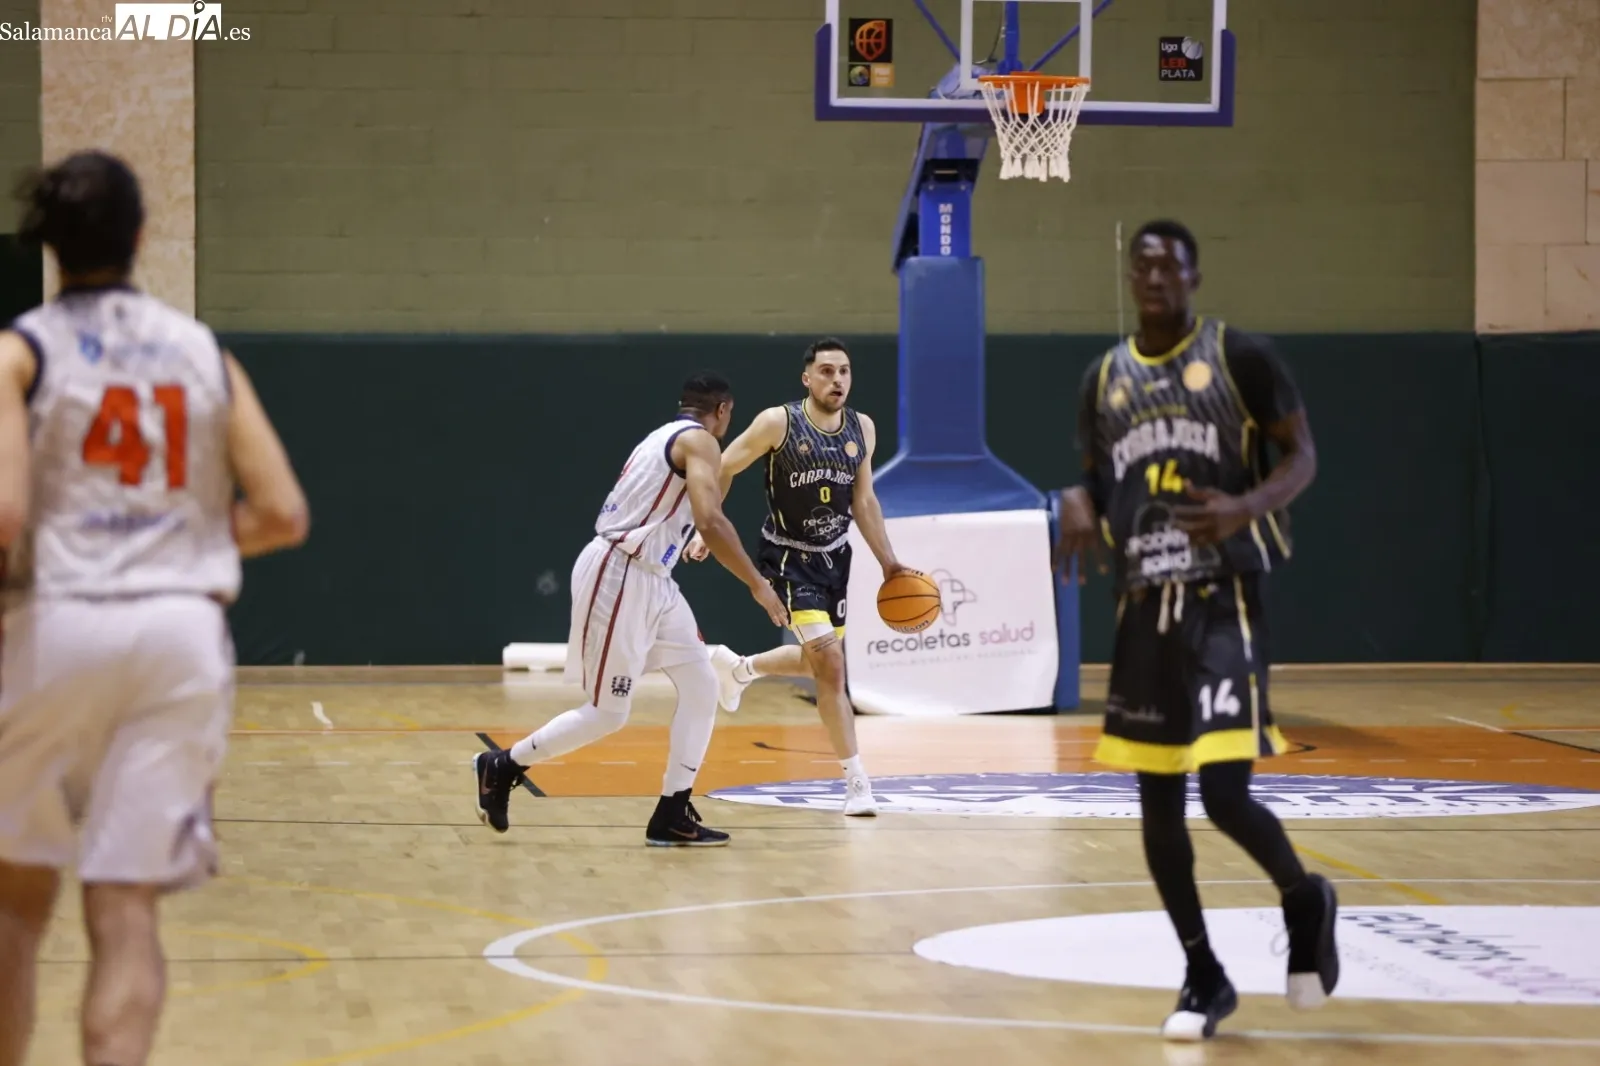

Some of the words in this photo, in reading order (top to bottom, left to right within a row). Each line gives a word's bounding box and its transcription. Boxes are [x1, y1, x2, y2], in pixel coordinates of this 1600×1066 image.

[1161, 42, 1178, 53] Liga
[1161, 58, 1187, 68] LEB
[1161, 69, 1196, 78] PLATA
[939, 203, 953, 256] MONDO
[82, 382, 188, 490] 41
[820, 486, 831, 503] 0
[1145, 459, 1182, 495] 14
[866, 629, 971, 655] recoletas
[979, 620, 1035, 646] salud
[1198, 678, 1241, 722] 14
